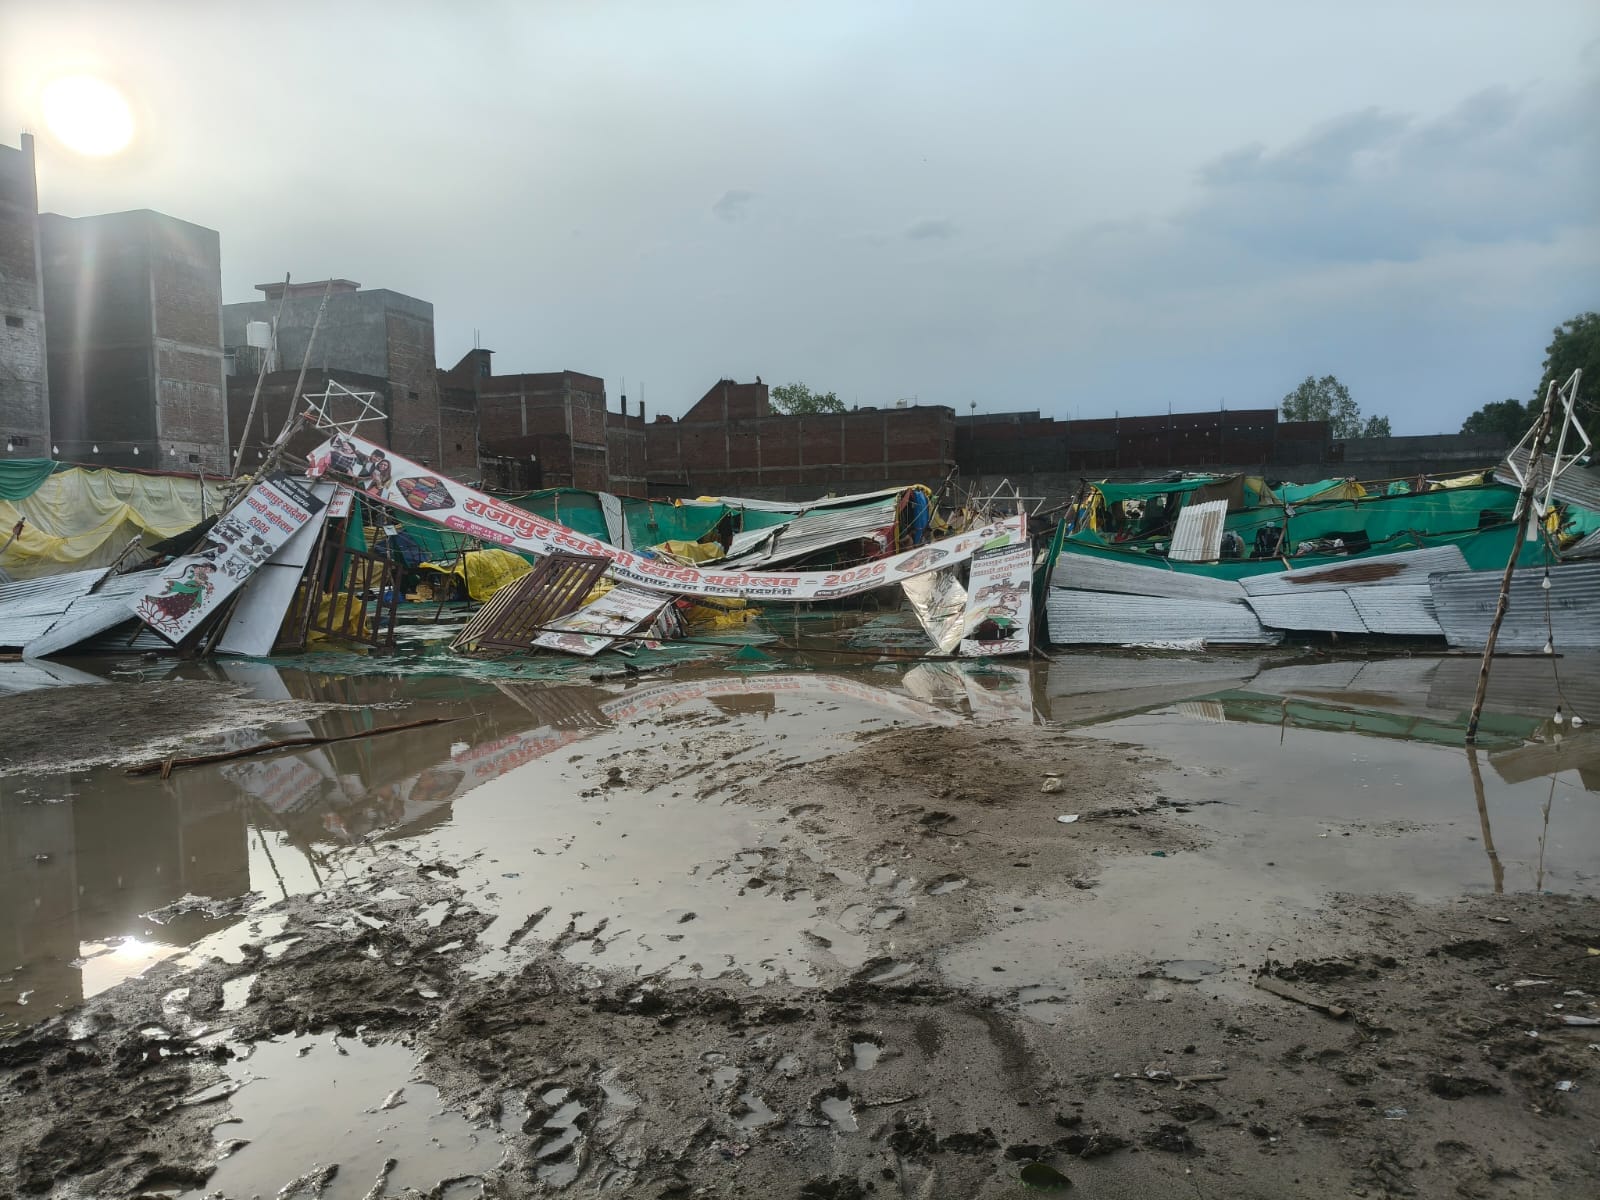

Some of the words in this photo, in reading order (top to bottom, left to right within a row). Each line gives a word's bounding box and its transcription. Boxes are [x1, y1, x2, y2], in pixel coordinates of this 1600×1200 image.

[249, 516, 270, 534] 2026
[464, 498, 549, 539] राजापुर
[552, 532, 635, 567] स्वदेशी
[638, 562, 702, 584] खादी
[704, 572, 800, 588] महोत्सव
[823, 563, 887, 587] 2026
